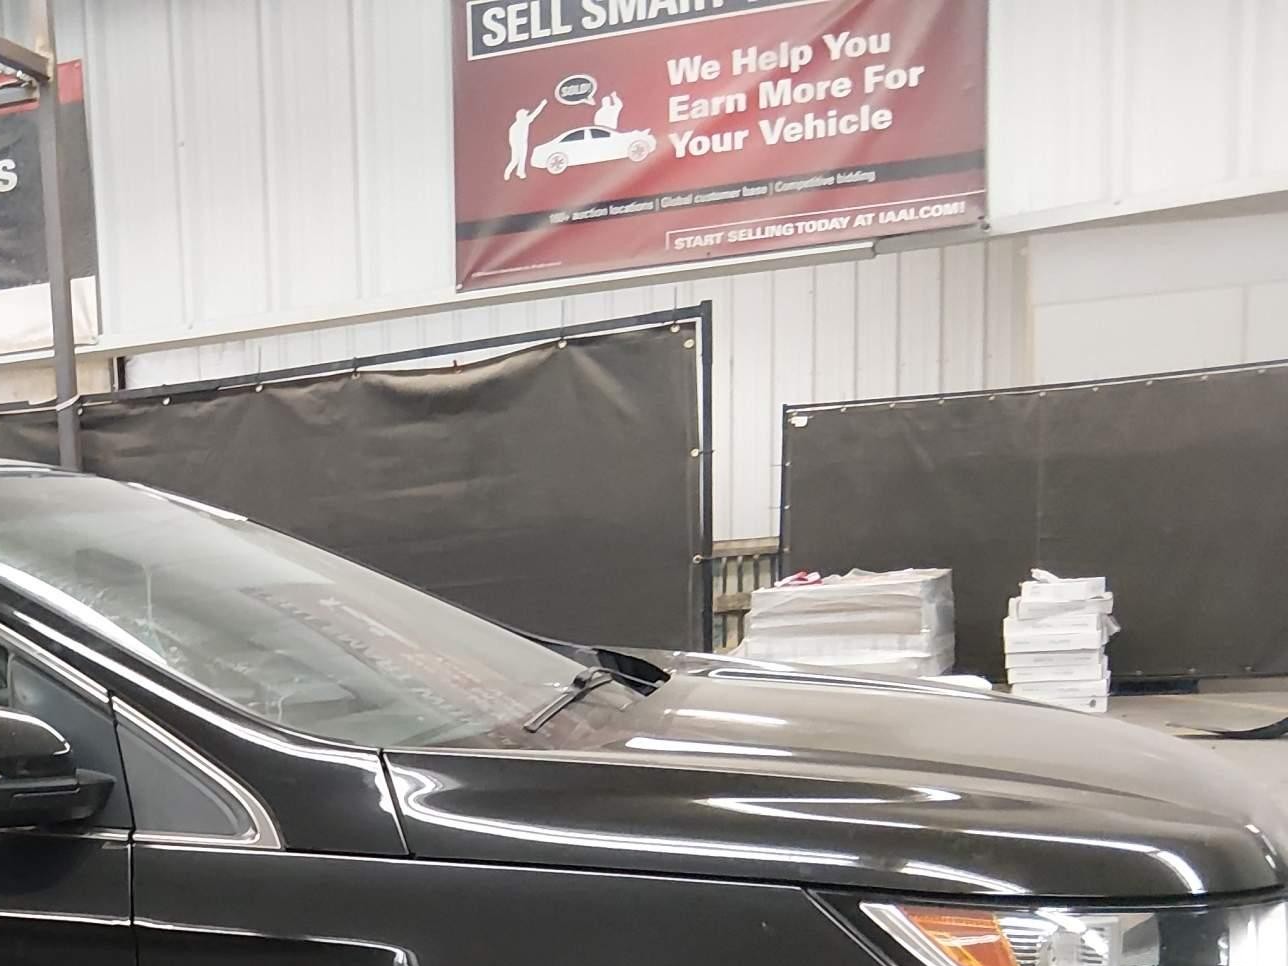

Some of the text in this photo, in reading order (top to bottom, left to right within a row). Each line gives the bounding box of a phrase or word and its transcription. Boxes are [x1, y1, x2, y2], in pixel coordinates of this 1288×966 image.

[482, 0, 572, 46] SELL
[667, 31, 891, 85] We Help You
[668, 64, 925, 123] Earn More For
[668, 104, 893, 159] Your Vehicle
[674, 233, 725, 251] START
[727, 224, 795, 243] SELLING
[796, 216, 850, 235] TODAY
[852, 212, 875, 227] AT
